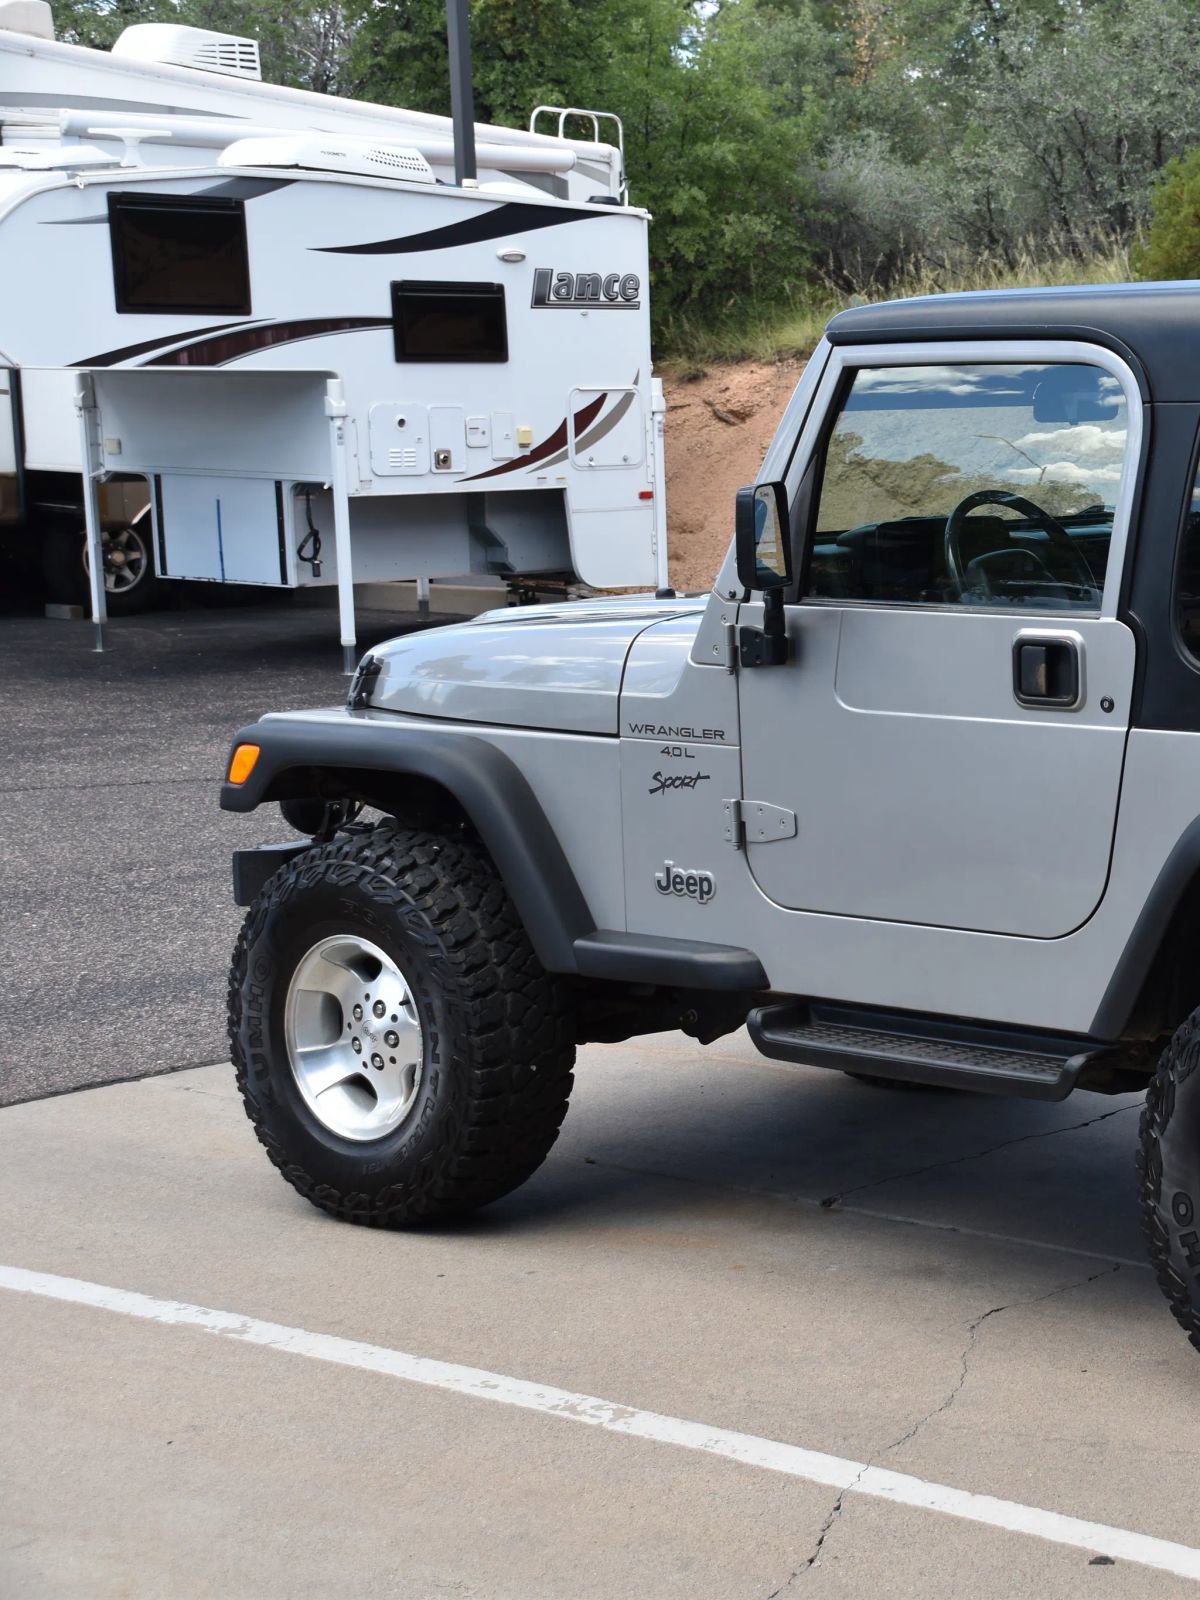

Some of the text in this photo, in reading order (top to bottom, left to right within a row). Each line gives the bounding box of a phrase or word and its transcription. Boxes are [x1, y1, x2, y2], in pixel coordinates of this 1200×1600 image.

[531, 268, 640, 309] Lance
[629, 723, 725, 740] WRANGLER
[656, 864, 714, 902] Jeep
